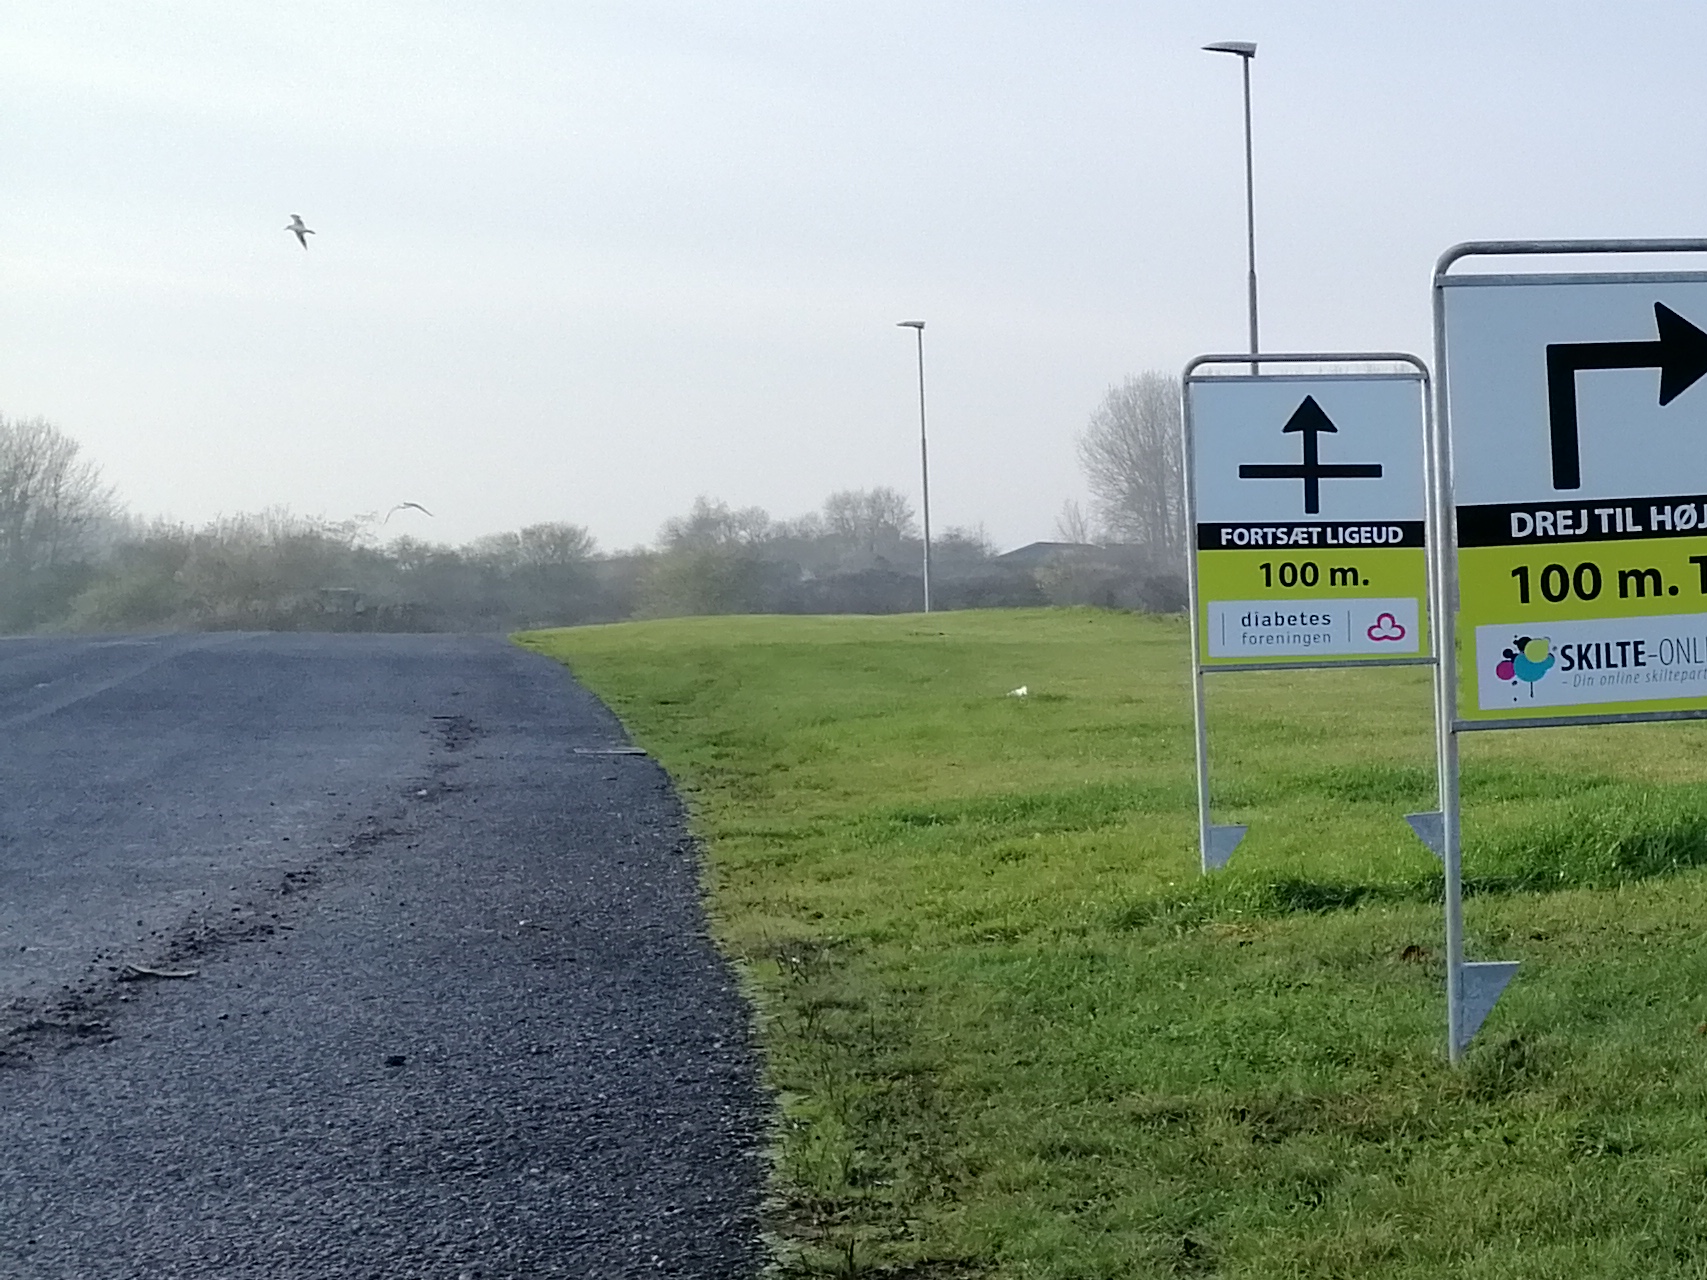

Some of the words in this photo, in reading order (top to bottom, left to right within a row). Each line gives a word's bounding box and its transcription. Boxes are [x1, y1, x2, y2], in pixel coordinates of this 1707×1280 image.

[1510, 509, 1588, 538] DREJ
[1594, 507, 1643, 533] TIL
[1220, 527, 1322, 546] FORTSÆT
[1326, 526, 1404, 545] LIGEUD
[1259, 562, 1319, 587] 100
[1330, 567, 1370, 587] m.
[1511, 562, 1602, 604] 100
[1618, 567, 1679, 599] m.
[1241, 611, 1331, 627] diabetes
[1242, 631, 1331, 647] foreningen
[1573, 673, 1594, 687] Din
[1600, 670, 1639, 686] online
